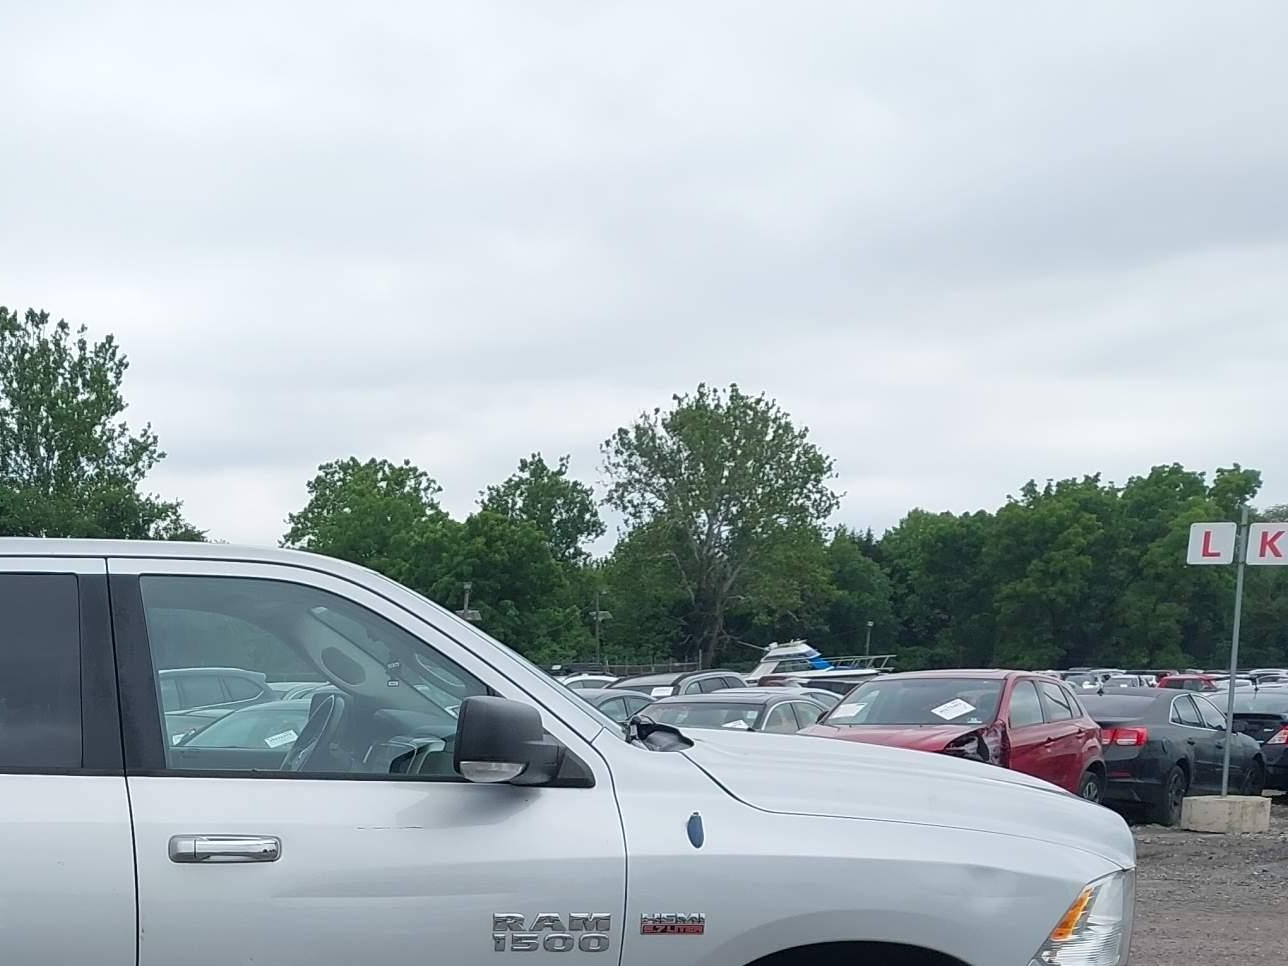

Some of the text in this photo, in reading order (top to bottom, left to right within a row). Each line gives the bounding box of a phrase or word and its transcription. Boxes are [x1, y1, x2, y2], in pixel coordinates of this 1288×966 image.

[1202, 531, 1221, 557] L
[1259, 531, 1285, 557] K
[493, 912, 611, 931] RAM
[493, 933, 610, 952] 1500
